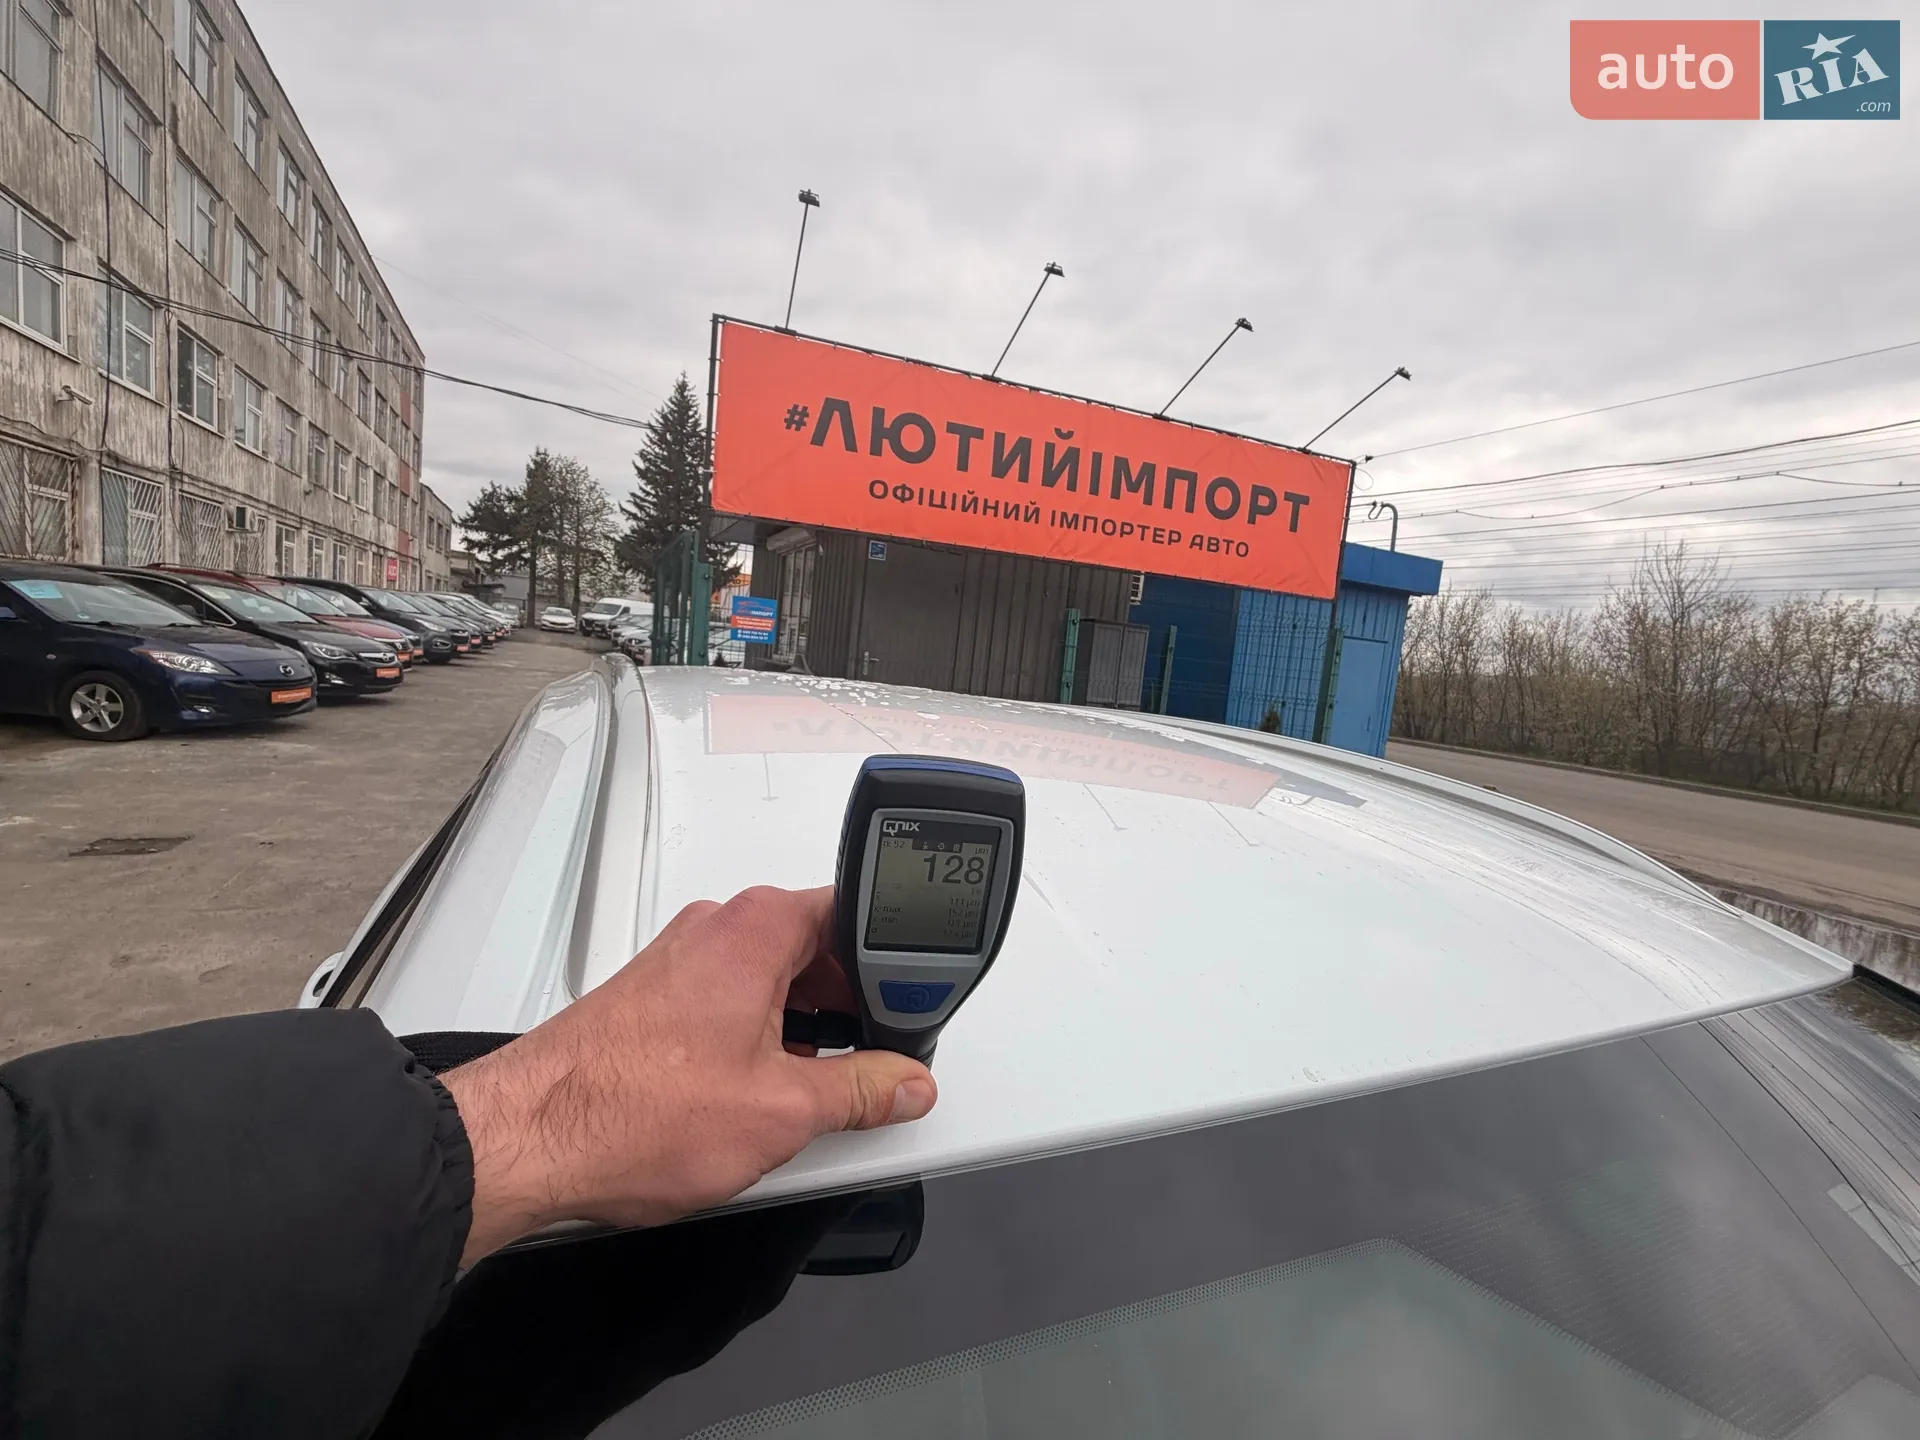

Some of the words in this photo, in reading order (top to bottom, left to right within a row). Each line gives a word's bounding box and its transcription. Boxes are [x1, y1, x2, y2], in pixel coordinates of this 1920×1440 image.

[784, 397, 1310, 533] #ЛЮТИЙІМПОРТ
[868, 479, 1041, 525] ОФІЦІЙНИЙ
[1050, 509, 1183, 546] ІМПОРТЕР
[1188, 534, 1250, 558] АВТО
[923, 853, 985, 885] 128
